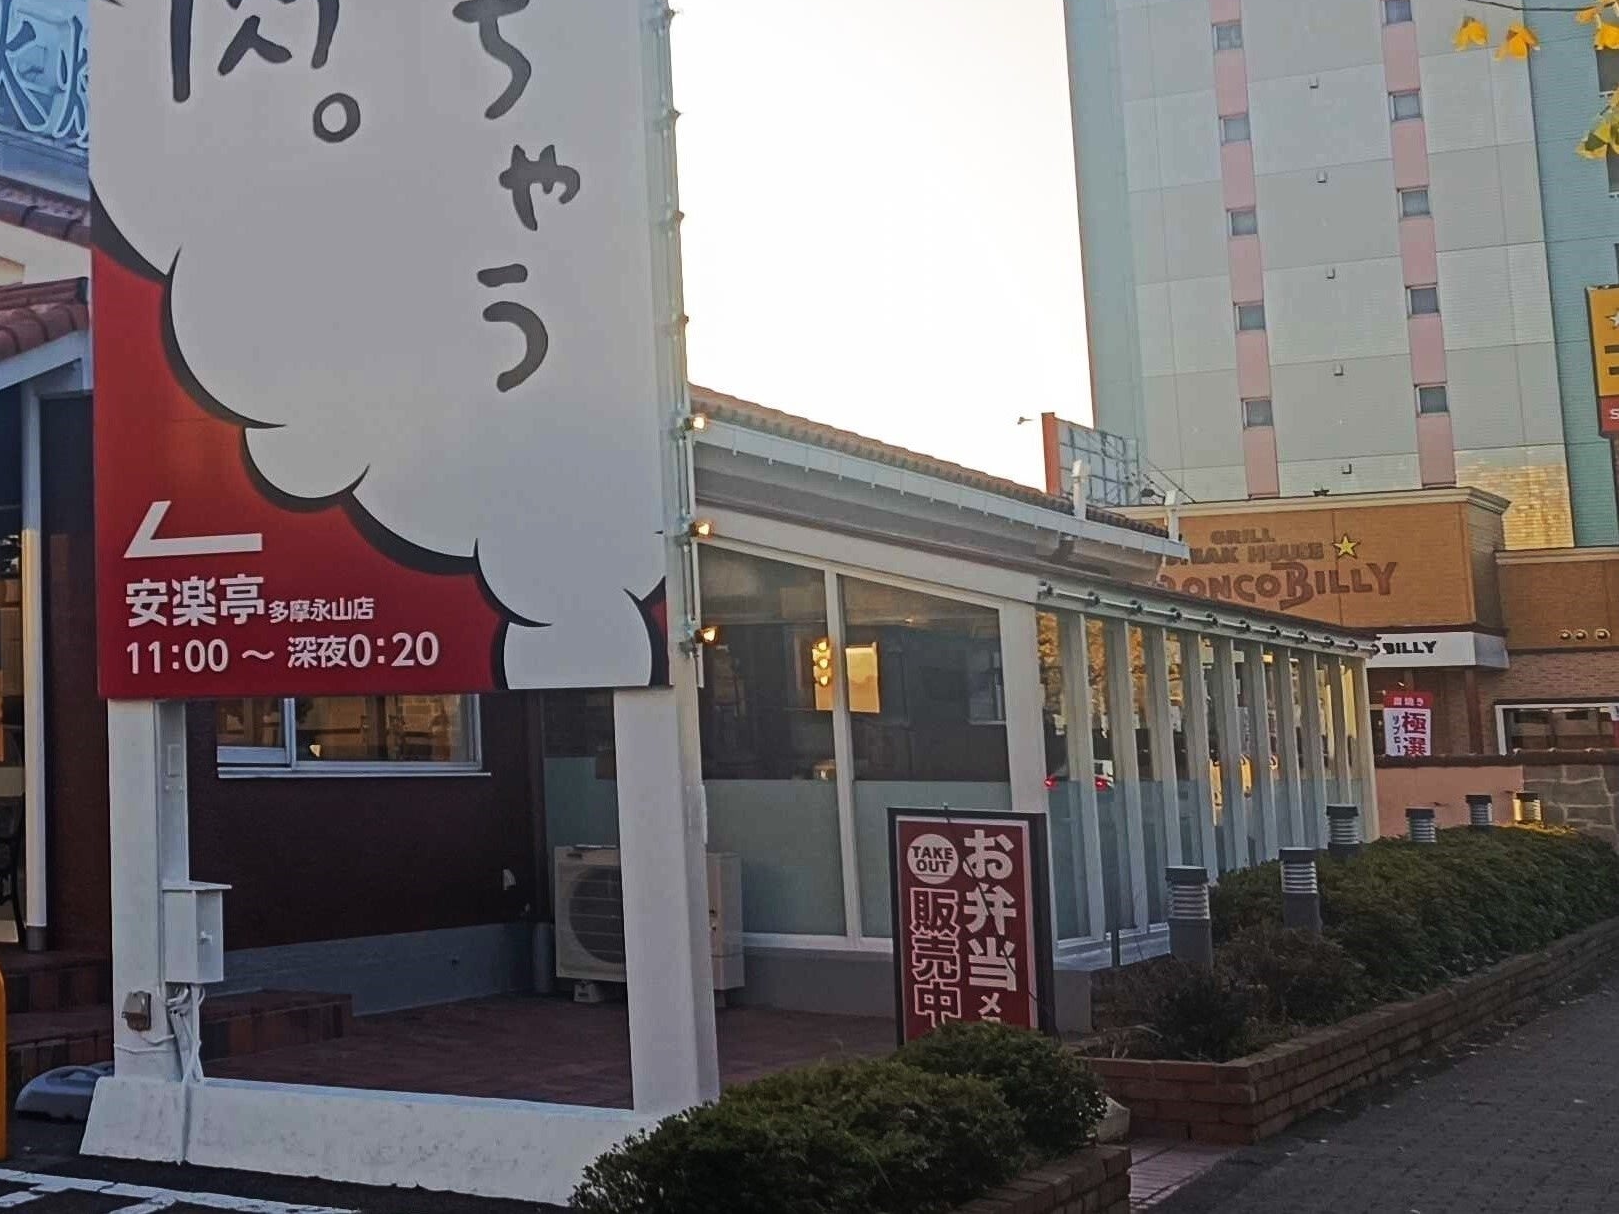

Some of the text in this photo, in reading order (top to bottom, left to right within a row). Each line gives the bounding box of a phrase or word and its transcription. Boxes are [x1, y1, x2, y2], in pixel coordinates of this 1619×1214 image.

[1248, 543, 1324, 563] HOUSE
[126, 574, 374, 627] 安楽亭 多摩永山店
[127, 638, 228, 674] 11:00
[911, 845, 954, 860] TAKE
[916, 860, 950, 873] OUT
[910, 887, 962, 1028] 販売中
